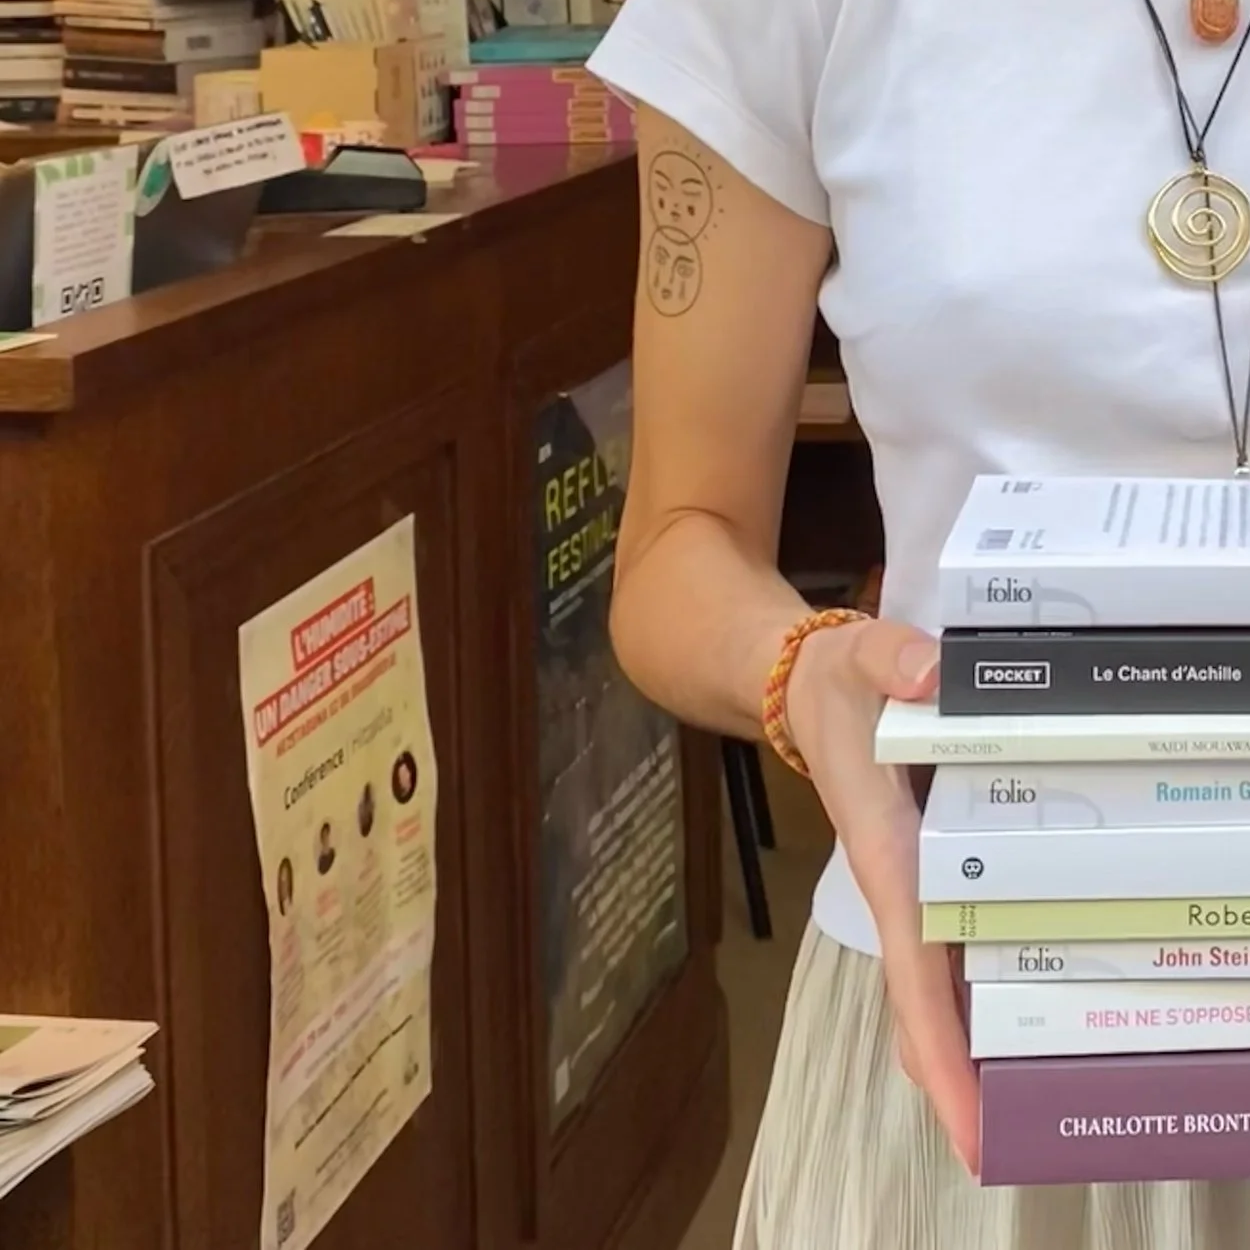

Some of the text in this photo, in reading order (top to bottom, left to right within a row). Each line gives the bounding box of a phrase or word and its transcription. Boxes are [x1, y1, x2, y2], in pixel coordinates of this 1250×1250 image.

[987, 576, 1033, 604] folio
[984, 669, 1043, 682] POCKET
[1093, 666, 1113, 682] Le
[1117, 666, 1167, 682] Chant
[1172, 665, 1243, 682] d'Achille
[990, 778, 1036, 804] folio
[1157, 782, 1232, 803] Romain
[1018, 946, 1064, 972] folio
[1152, 947, 1202, 968] John
[1086, 1010, 1130, 1029] RIEN
[1136, 1009, 1162, 1028] NE
[1059, 1114, 1179, 1137] CHARLOTTE
